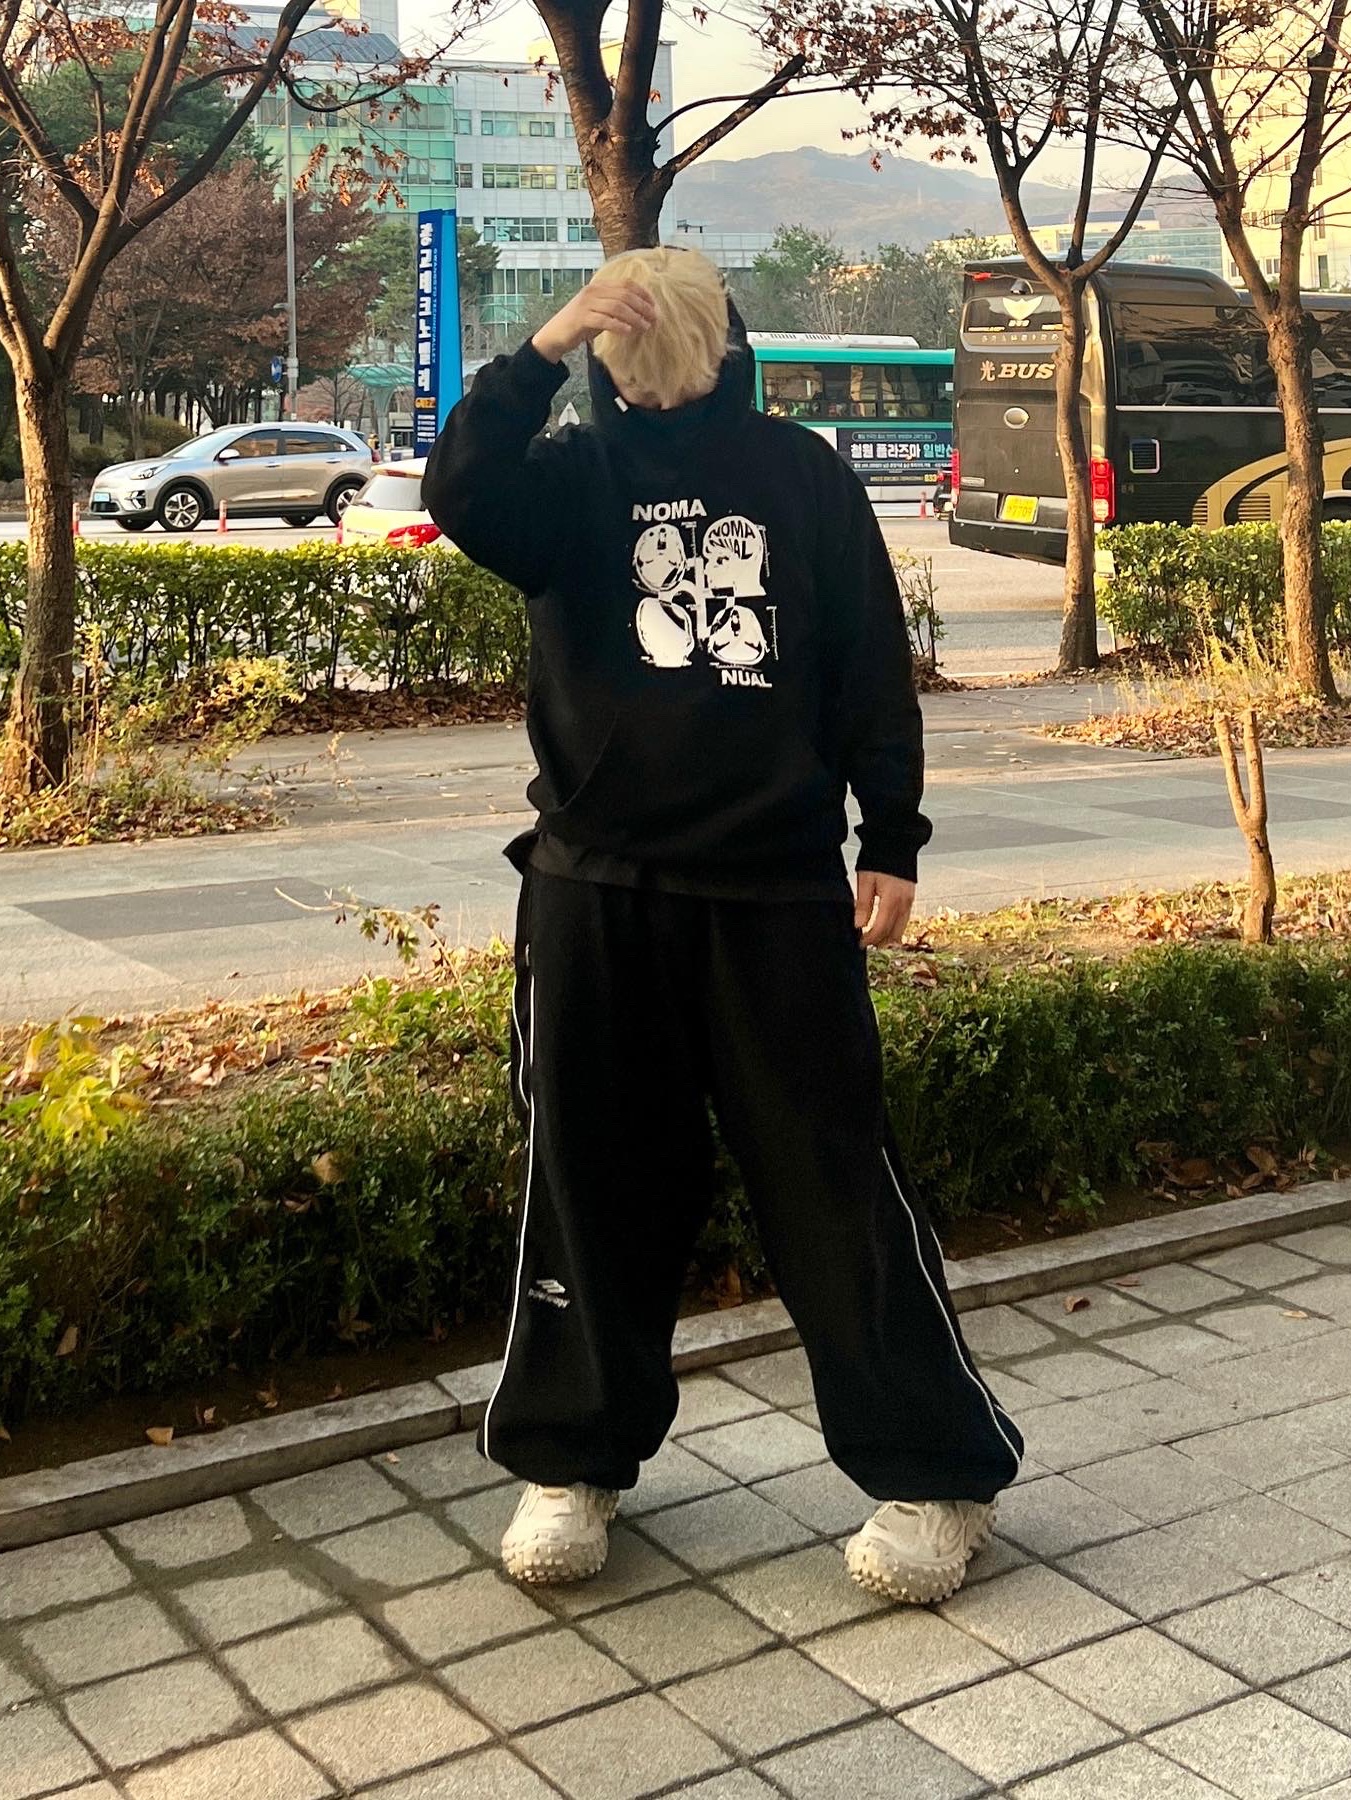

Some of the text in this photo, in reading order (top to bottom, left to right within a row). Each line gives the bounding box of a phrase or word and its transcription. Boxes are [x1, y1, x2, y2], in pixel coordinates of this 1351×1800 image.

[980, 360, 1055, 381] 光 BUS
[876, 443, 920, 458] 플라즈마
[632, 499, 707, 521] NOMA
[708, 520, 755, 539] NOMA
[709, 538, 753, 559] NUAL
[721, 669, 772, 688] NUAL
